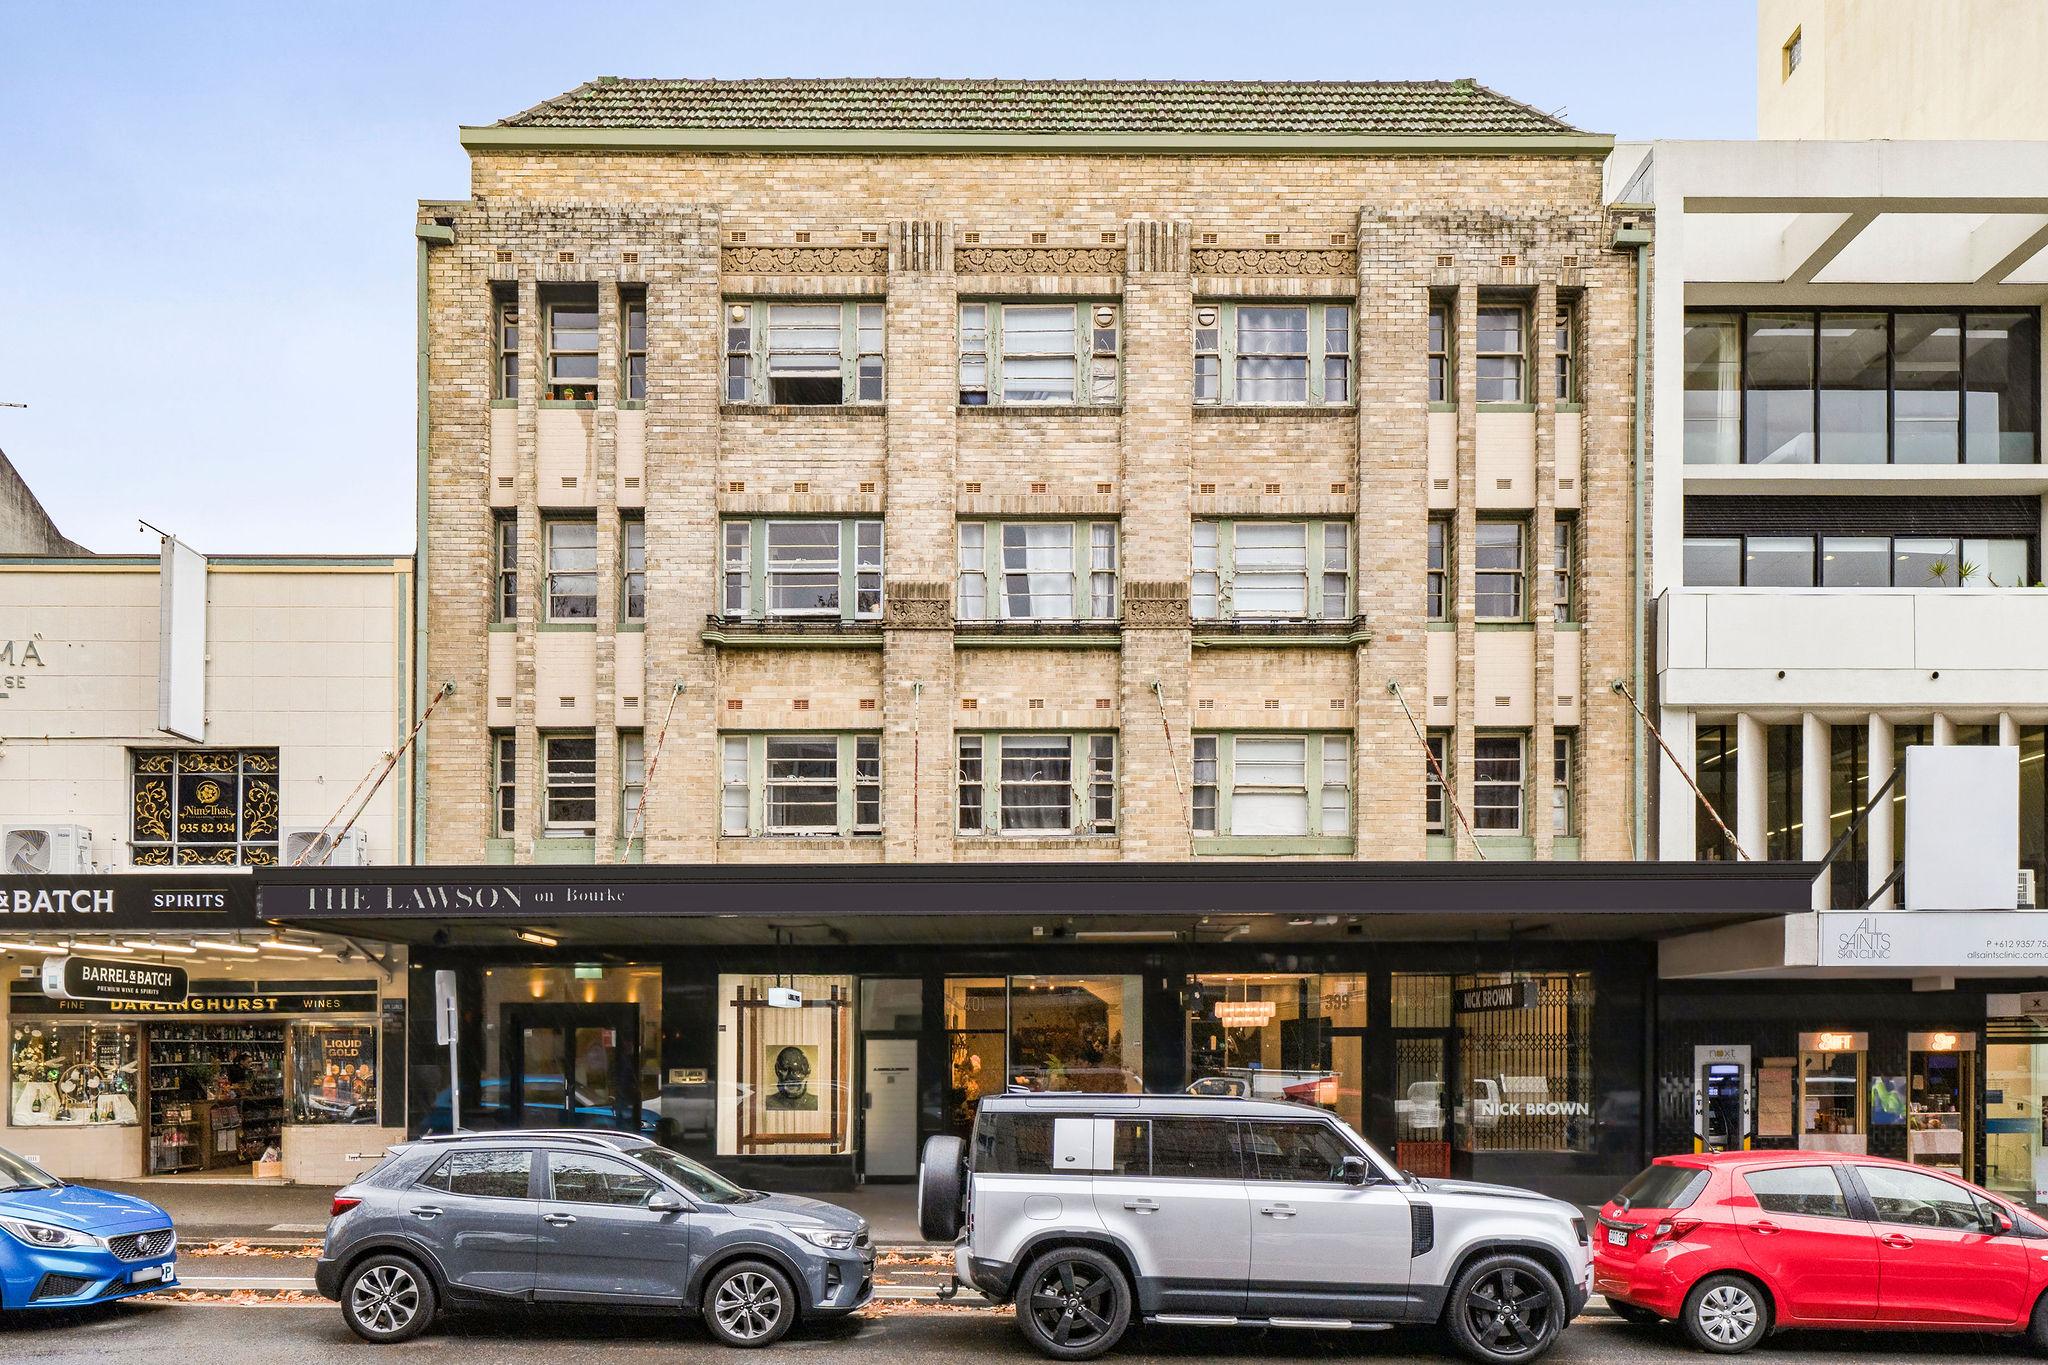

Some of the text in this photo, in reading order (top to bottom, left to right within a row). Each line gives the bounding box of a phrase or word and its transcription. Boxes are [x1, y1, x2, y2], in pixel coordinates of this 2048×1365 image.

[180, 823, 235, 833] 935 82 934
[154, 894, 225, 907] SPIRITS
[308, 886, 625, 910] THE LAWSON on Bourke
[1854, 917, 1883, 934] ALL
[1838, 933, 1891, 950] SAINTS
[1986, 940, 2048, 948] P +612 9357 75
[97, 985, 120, 993] PREMIUM
[140, 988, 159, 996] SPIRITS
[1464, 987, 1513, 1009] NICK BROWN
[60, 1001, 85, 1010] FINE
[303, 1000, 341, 1008] WINES
[324, 1040, 362, 1048] LIQUID
[328, 1049, 359, 1057] GOLD
[1481, 1103, 1589, 1116] NICK BROWN
[165, 1266, 172, 1279] P
